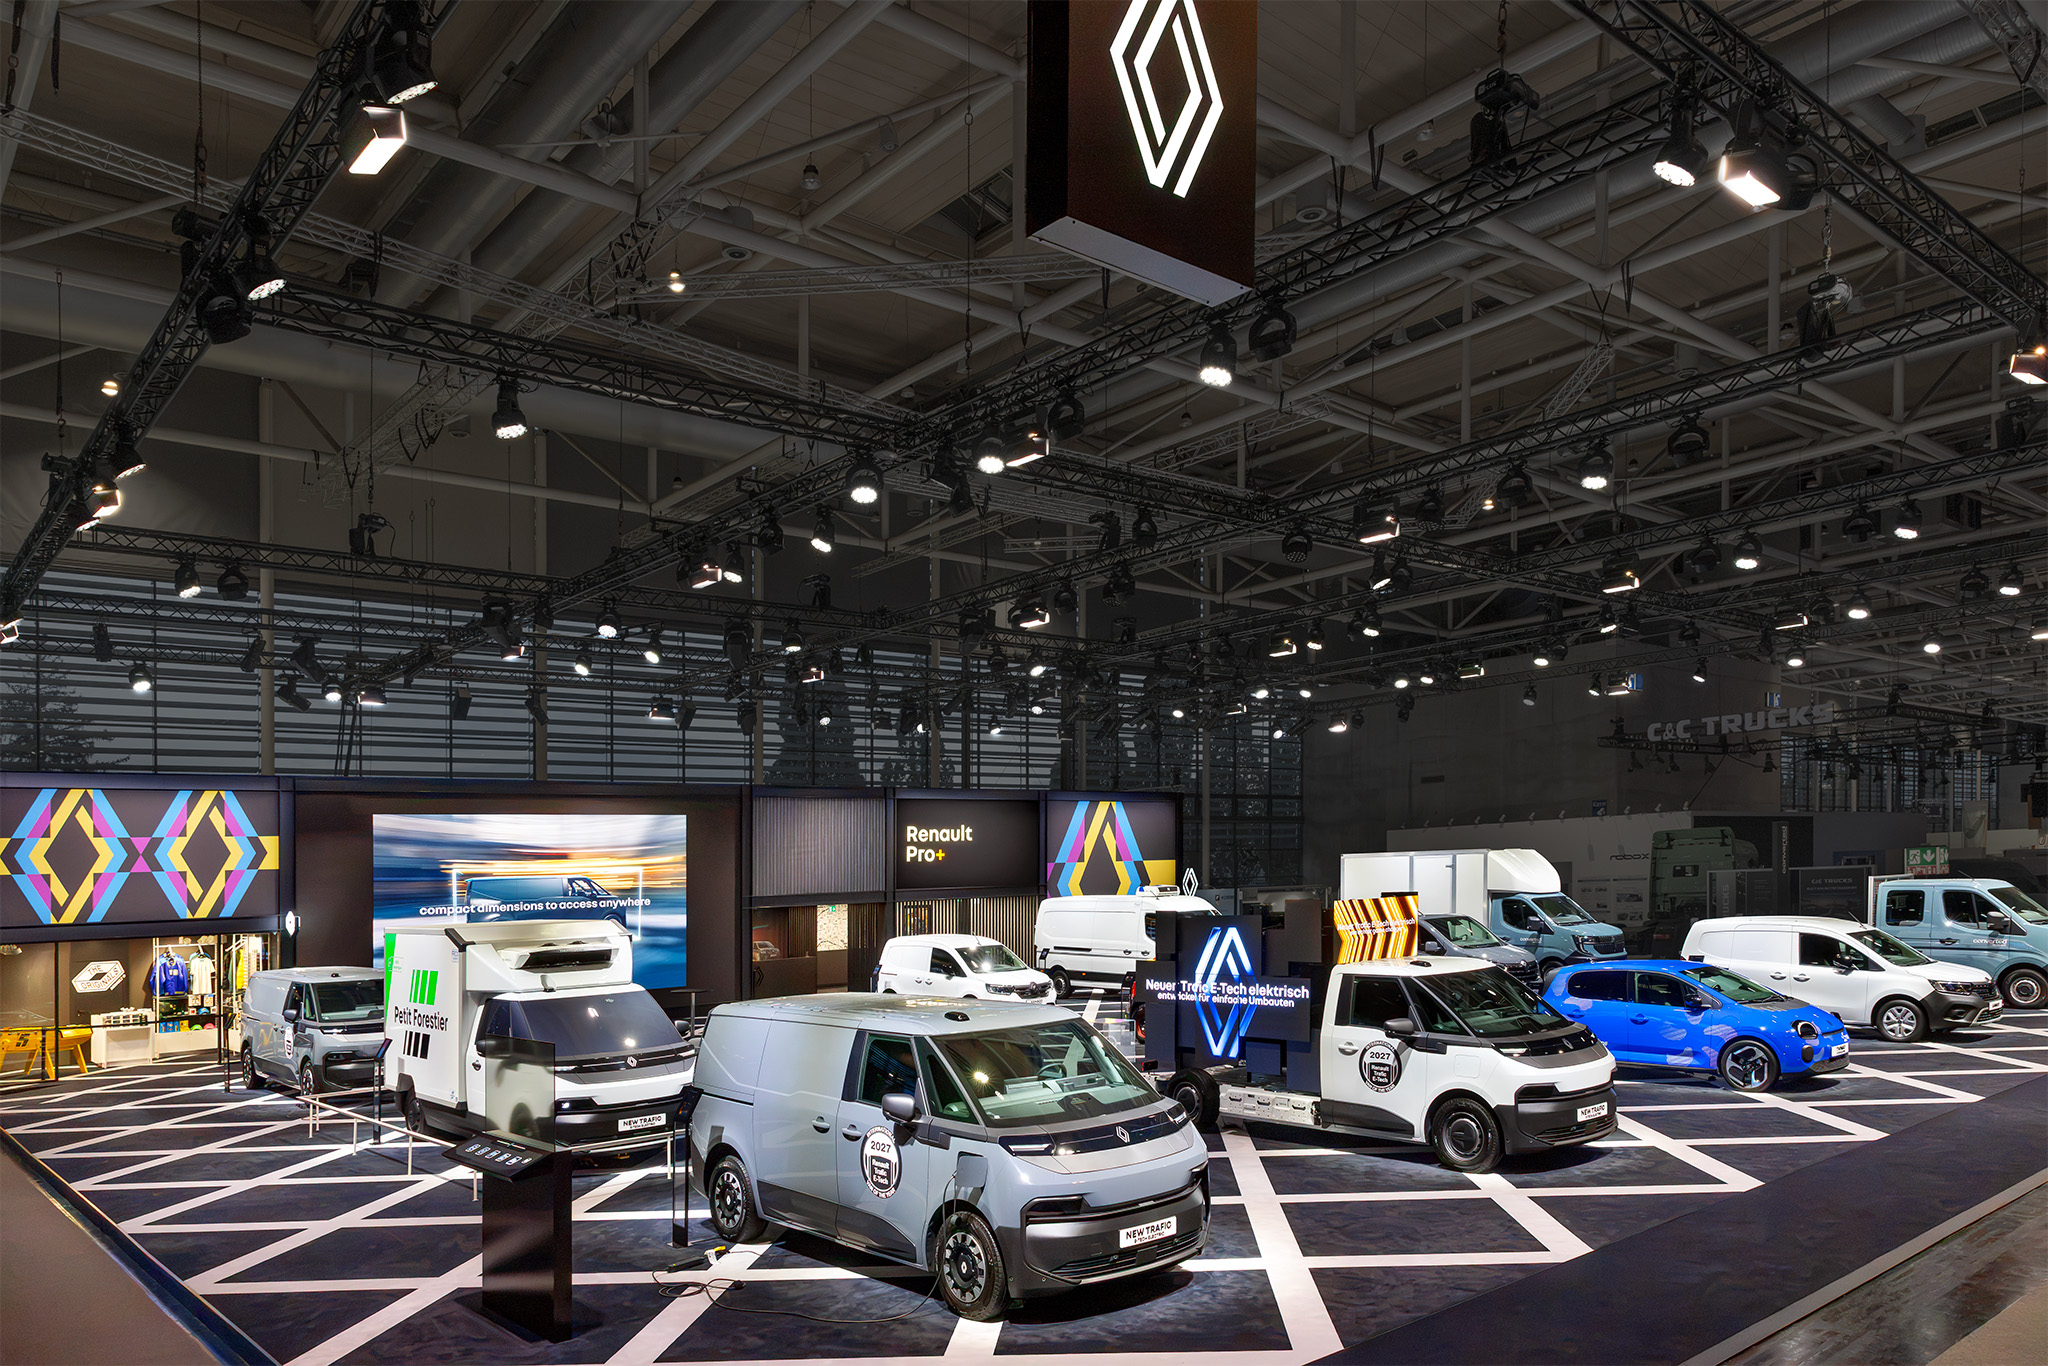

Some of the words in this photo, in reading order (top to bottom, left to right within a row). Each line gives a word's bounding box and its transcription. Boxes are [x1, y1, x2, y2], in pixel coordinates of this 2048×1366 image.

[1647, 719, 1691, 742] C&C
[1701, 703, 1834, 736] TRUCKS
[906, 824, 974, 843] Renault
[906, 846, 946, 863] Pro+
[419, 903, 476, 917] compact
[477, 901, 544, 913] dimensions
[545, 900, 558, 911] to
[559, 899, 598, 911] access
[599, 896, 651, 910] anywhere
[80, 967, 120, 989] ORIGINALS
[88, 964, 104, 976] THE
[1145, 978, 1176, 992] Neuer
[1210, 982, 1247, 996] E-Tech
[1248, 983, 1310, 999] elektrisch
[1198, 992, 1210, 1003] für
[1249, 995, 1295, 1008] Umbauten
[394, 1005, 412, 1025] Petit
[413, 1008, 449, 1032] Forestier
[1369, 1051, 1391, 1060] 2027
[1371, 1064, 1390, 1072] Renault
[623, 1118, 639, 1127] NEW
[639, 1115, 662, 1125] TRAFIC
[870, 1140, 892, 1153] 2027
[871, 1158, 890, 1170] Renault
[874, 1166, 888, 1177] Trafic
[1126, 1227, 1145, 1240] NEW
[1145, 1220, 1172, 1235] TRAFIC
